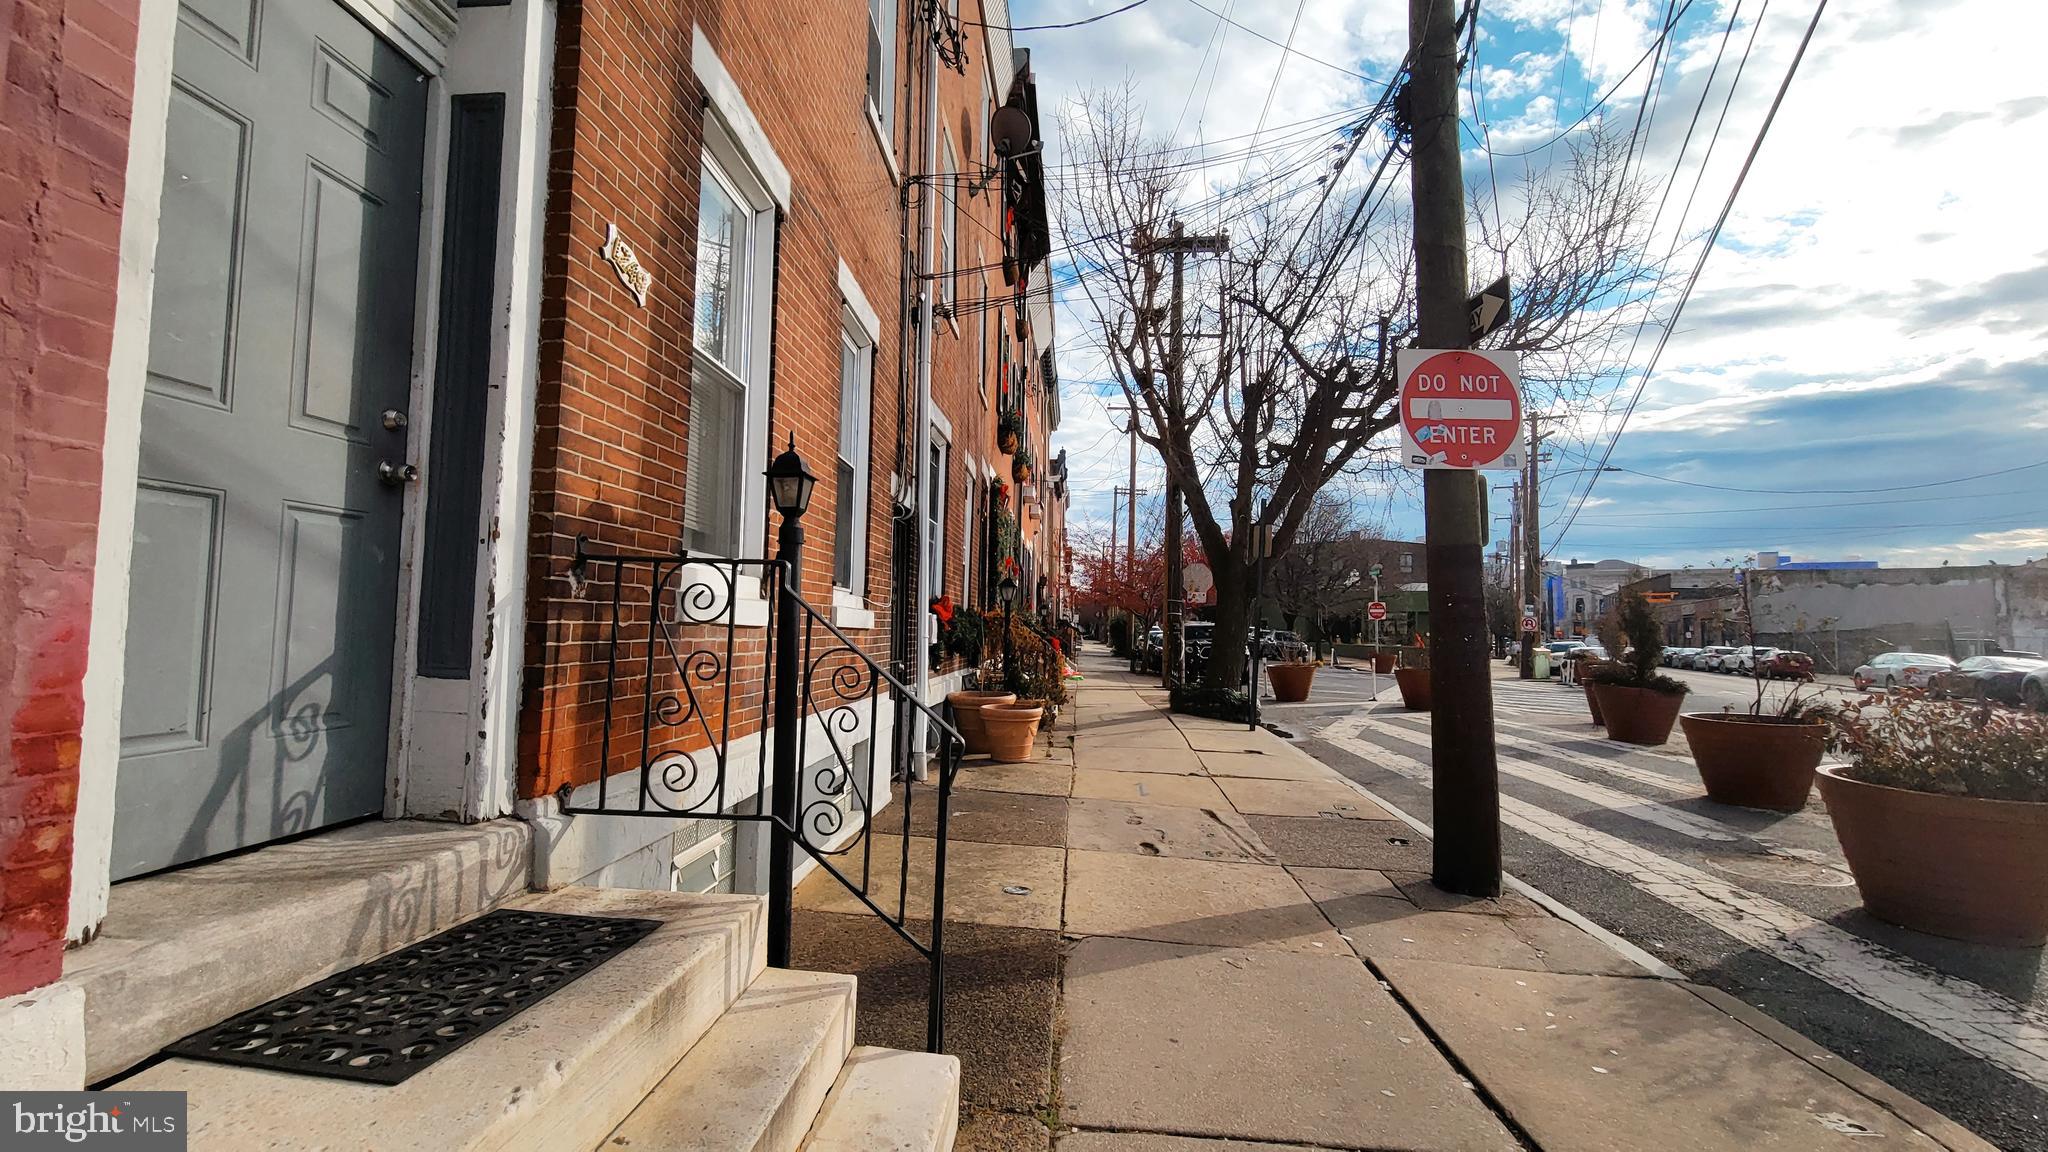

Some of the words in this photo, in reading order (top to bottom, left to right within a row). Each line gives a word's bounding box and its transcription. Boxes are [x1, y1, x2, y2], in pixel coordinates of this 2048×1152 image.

[1418, 374, 1446, 392] DO
[1460, 375, 1500, 393] NOT
[1429, 425, 1496, 444] ENTER
